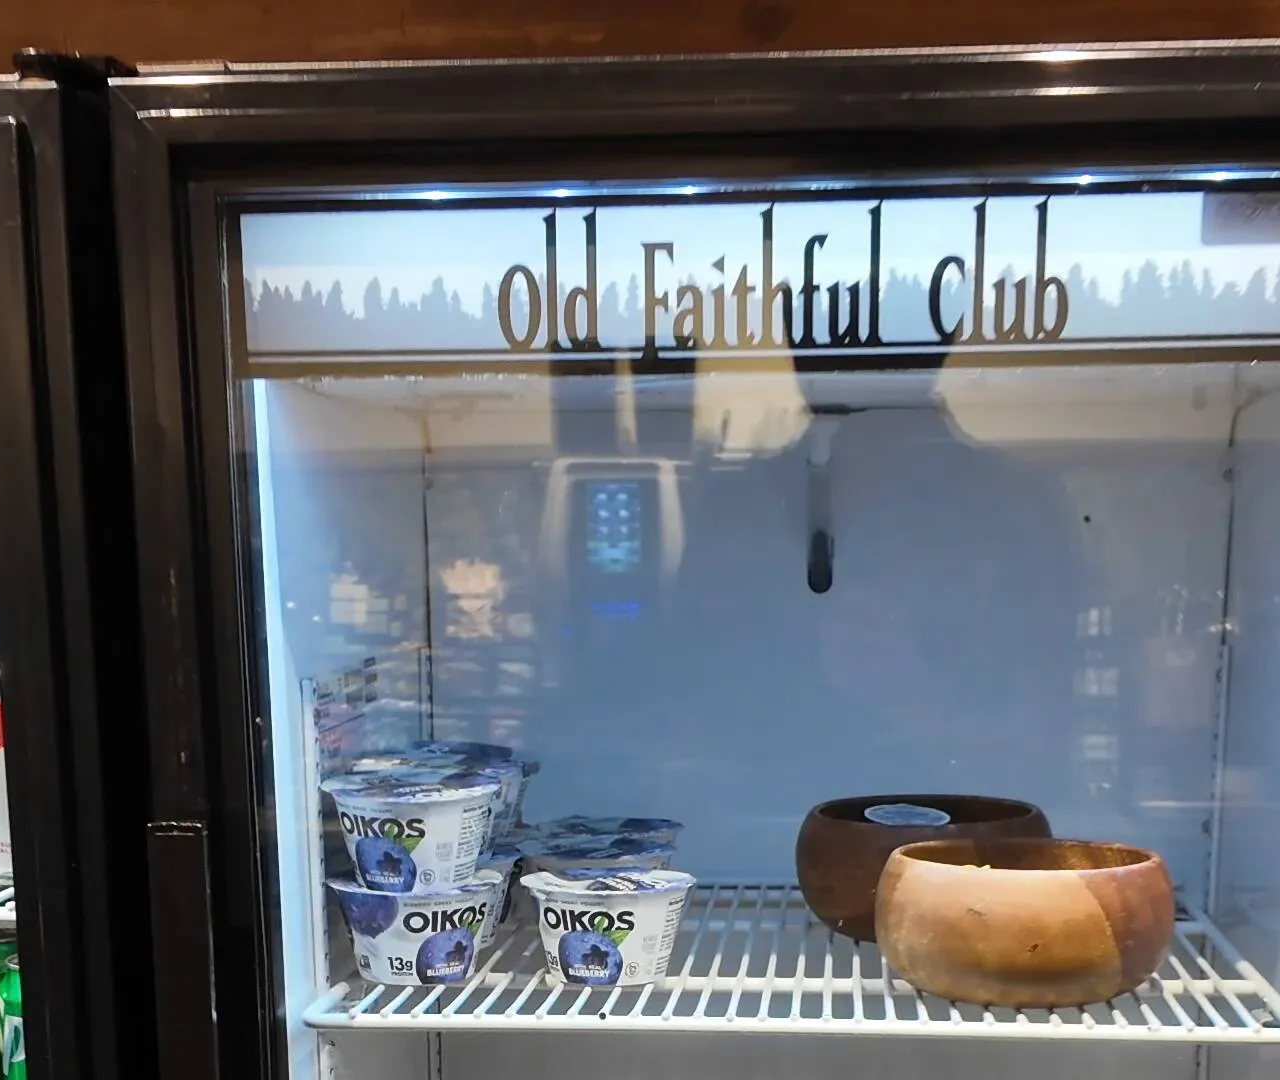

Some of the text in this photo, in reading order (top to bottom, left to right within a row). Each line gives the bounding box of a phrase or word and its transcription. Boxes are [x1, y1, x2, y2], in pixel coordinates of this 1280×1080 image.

[498, 195, 1069, 361] Old Faithful Club
[340, 811, 426, 839] OIKOS
[403, 902, 487, 933] OIKOS
[543, 906, 635, 932] OIKOS
[387, 956, 413, 973] 13g
